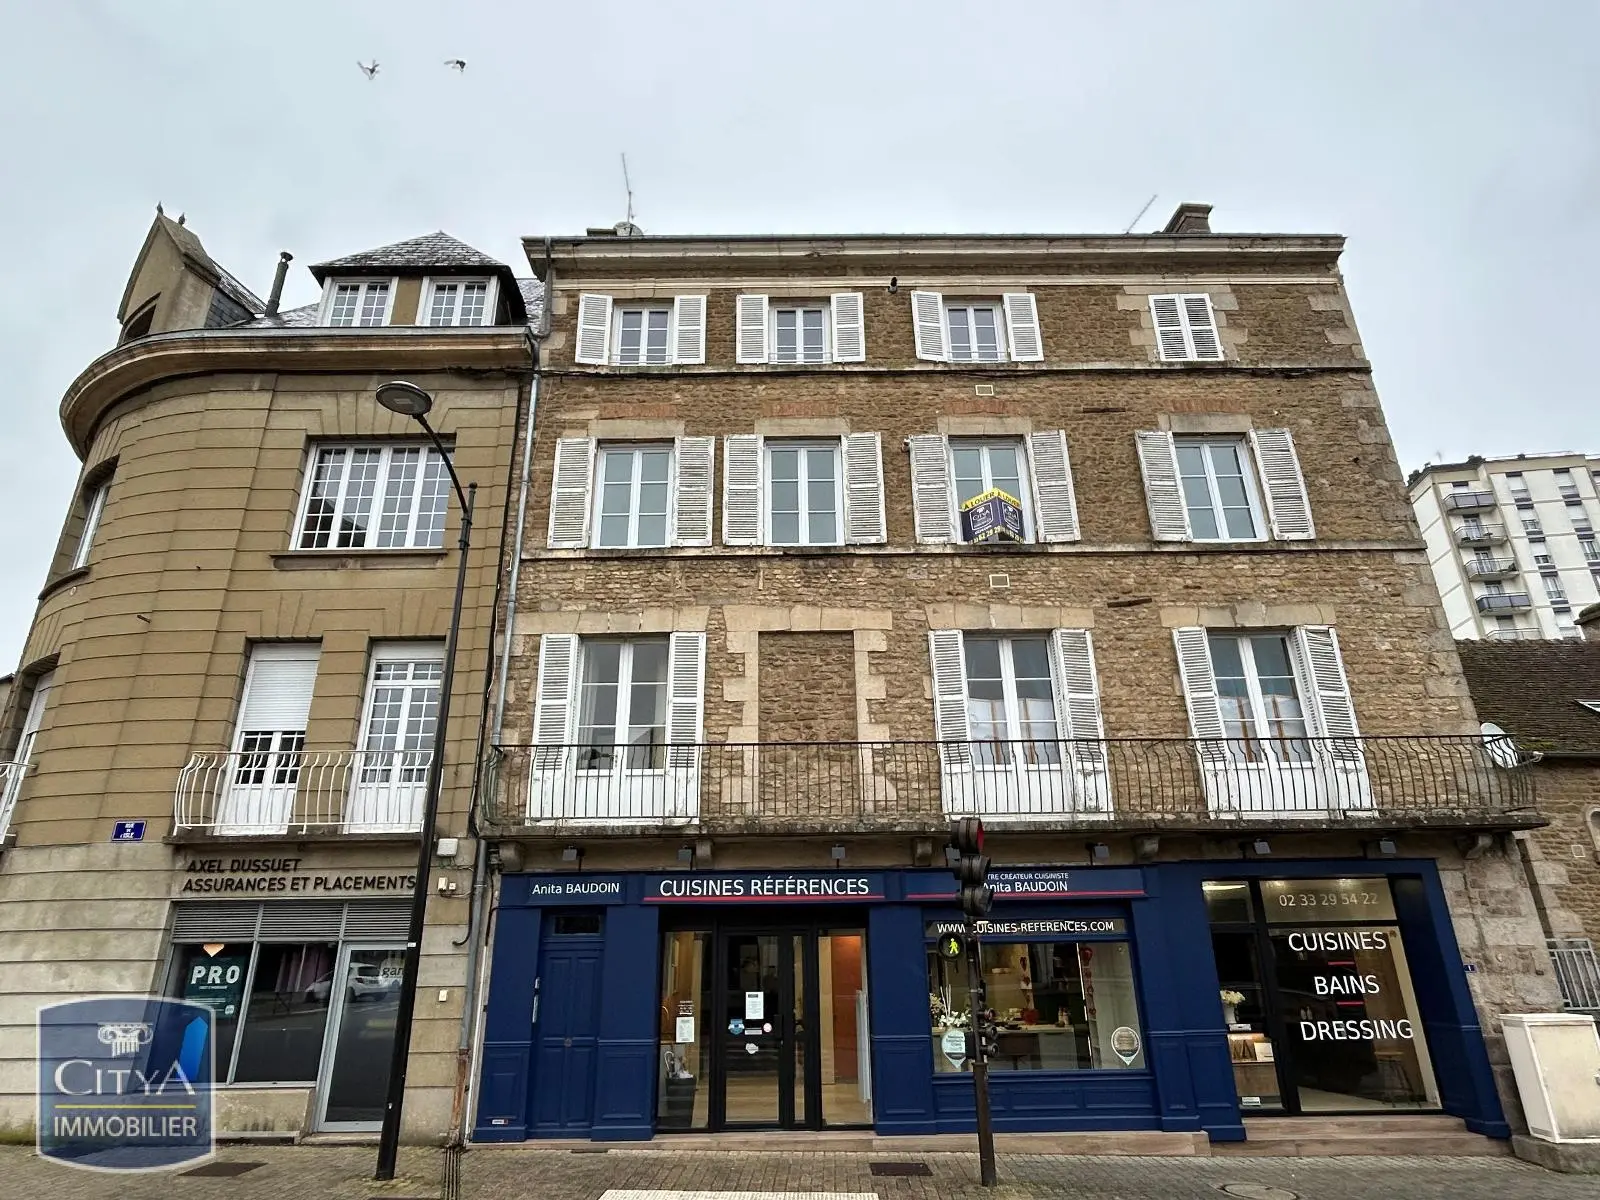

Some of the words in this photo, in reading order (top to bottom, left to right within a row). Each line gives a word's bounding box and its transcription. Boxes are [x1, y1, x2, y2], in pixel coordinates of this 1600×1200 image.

[186, 859, 226, 873] AXEL
[230, 858, 302, 873] DUSSUET
[182, 877, 286, 892] ASSURANCES
[290, 877, 310, 890] ET
[313, 875, 417, 890] PLACEMENTS
[1034, 872, 1069, 880] CUISINISTE
[532, 882, 562, 895] Anita
[566, 882, 620, 894] BAUDOIN
[659, 879, 744, 897] CUISINES
[750, 875, 869, 896] RÉFÉRENCES
[983, 881, 1011, 892] Anita
[1015, 881, 1068, 892] BAUDOIN
[1279, 894, 1296, 907] 02
[1300, 894, 1317, 906] 33
[1321, 893, 1337, 905] 29
[1341, 893, 1358, 905] 54
[937, 921, 1114, 934] WWWUISINES-REFERENCES.COM
[1288, 931, 1387, 951] CUISINES
[191, 965, 240, 985] PRO
[1313, 975, 1380, 995] BAINS
[1300, 1019, 1414, 1041] DRESSING
